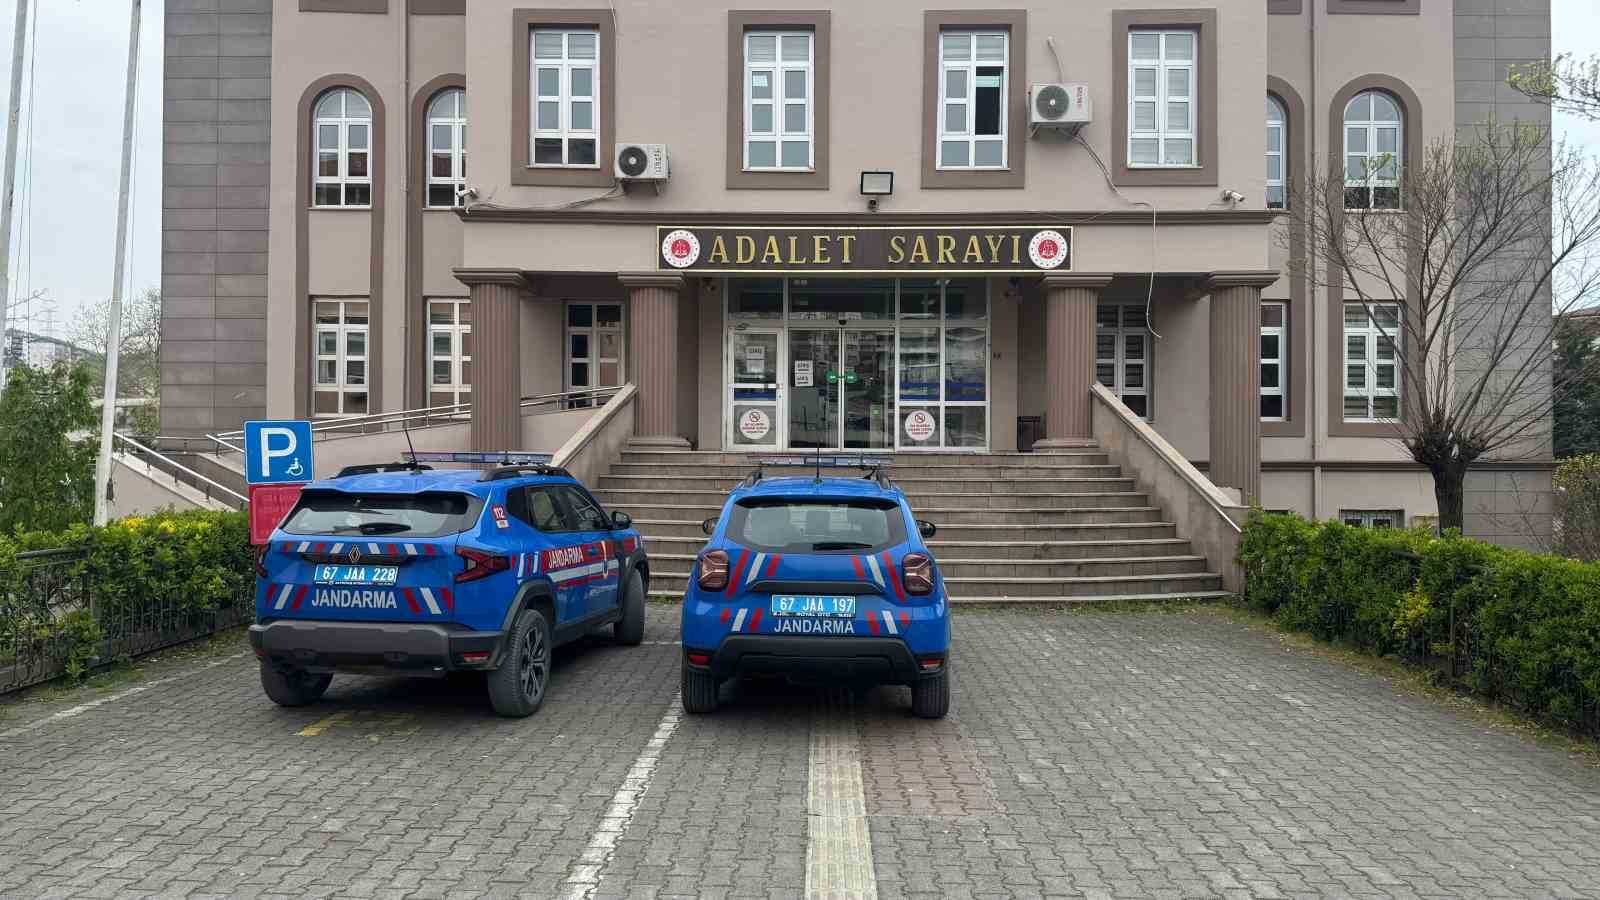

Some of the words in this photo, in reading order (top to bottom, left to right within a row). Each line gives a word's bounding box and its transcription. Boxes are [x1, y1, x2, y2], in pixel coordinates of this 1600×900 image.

[708, 235, 857, 264] ADALET
[887, 235, 1023, 264] SARAYI
[260, 427, 296, 477] P
[548, 547, 583, 569] JANDARMA
[322, 566, 338, 580] 67
[343, 567, 366, 580] JAA
[372, 567, 395, 581] 228
[312, 589, 397, 609] JANDARMA
[780, 598, 795, 612] 67
[802, 598, 824, 612] JAA
[832, 599, 854, 613] 197
[774, 619, 854, 634] JANDARMA
